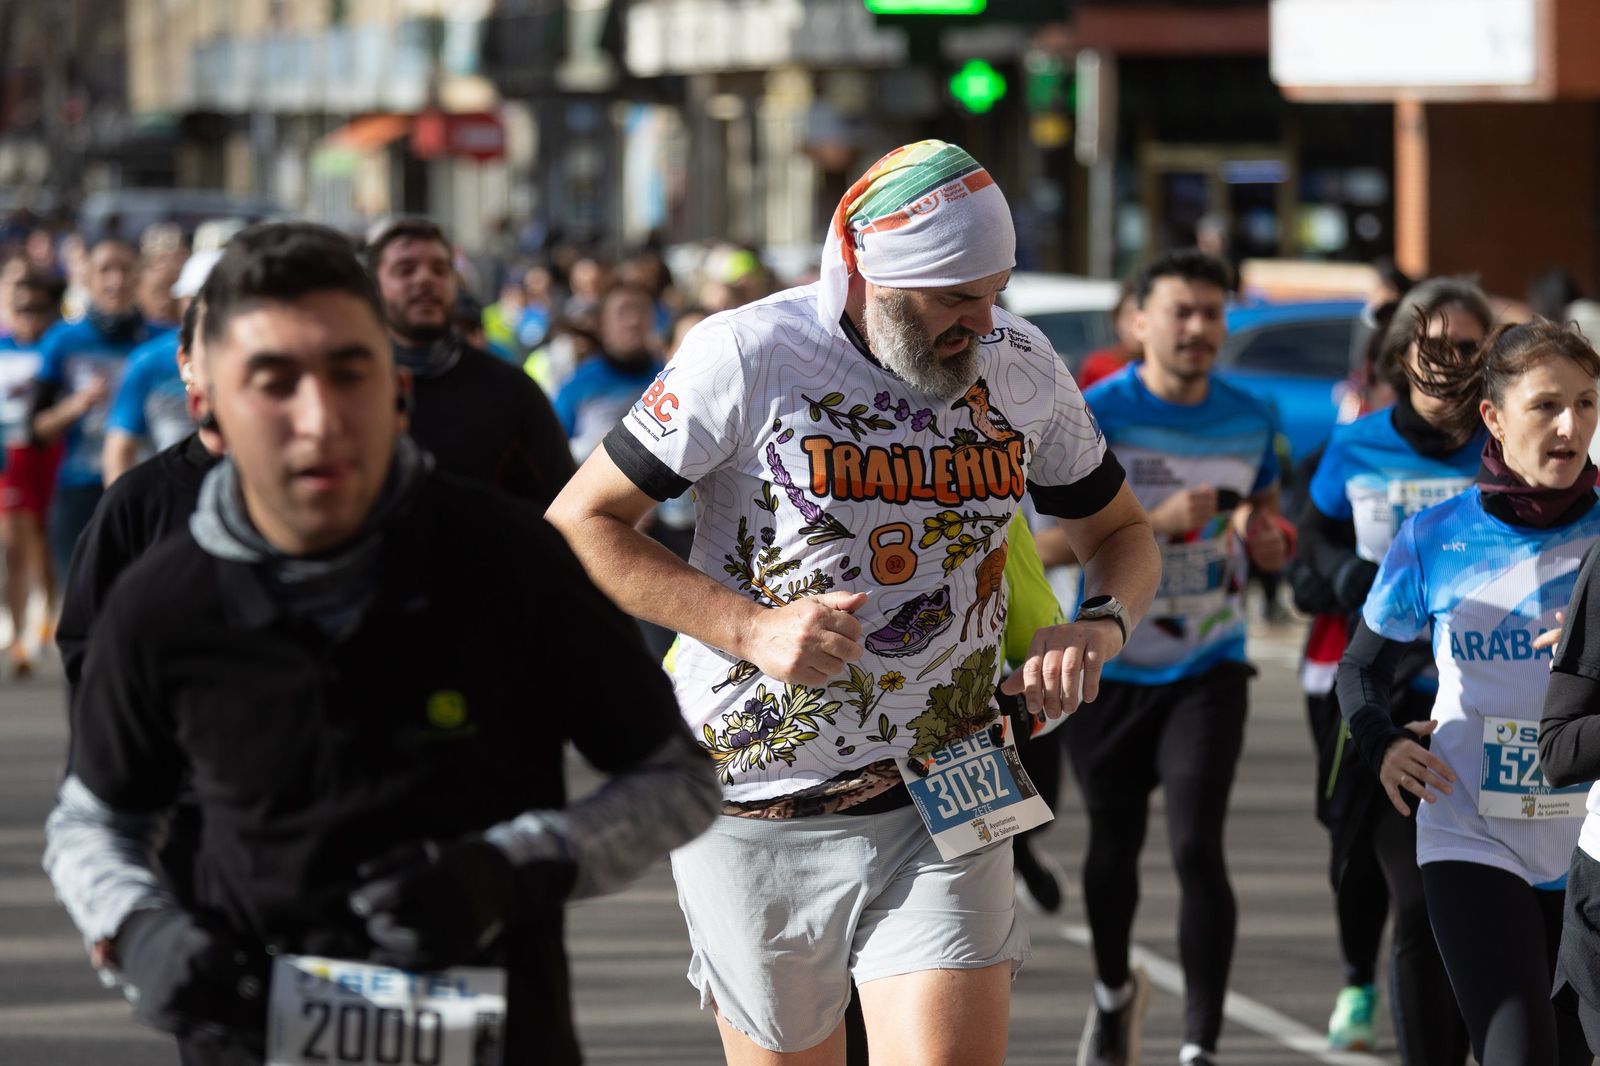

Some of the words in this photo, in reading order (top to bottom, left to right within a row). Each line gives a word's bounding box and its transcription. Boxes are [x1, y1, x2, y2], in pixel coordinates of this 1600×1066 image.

[1009, 340, 1032, 352] Things
[889, 559, 901, 570] 32
[931, 728, 995, 766] SETE
[1499, 746, 1552, 787] 52
[925, 755, 1010, 820] 3032
[1529, 787, 1552, 795] MARY
[972, 804, 993, 818] ZETE
[990, 815, 1016, 830] Ayuntamiento
[999, 824, 1020, 835] Salamanca
[302, 1001, 443, 1066] 2000
